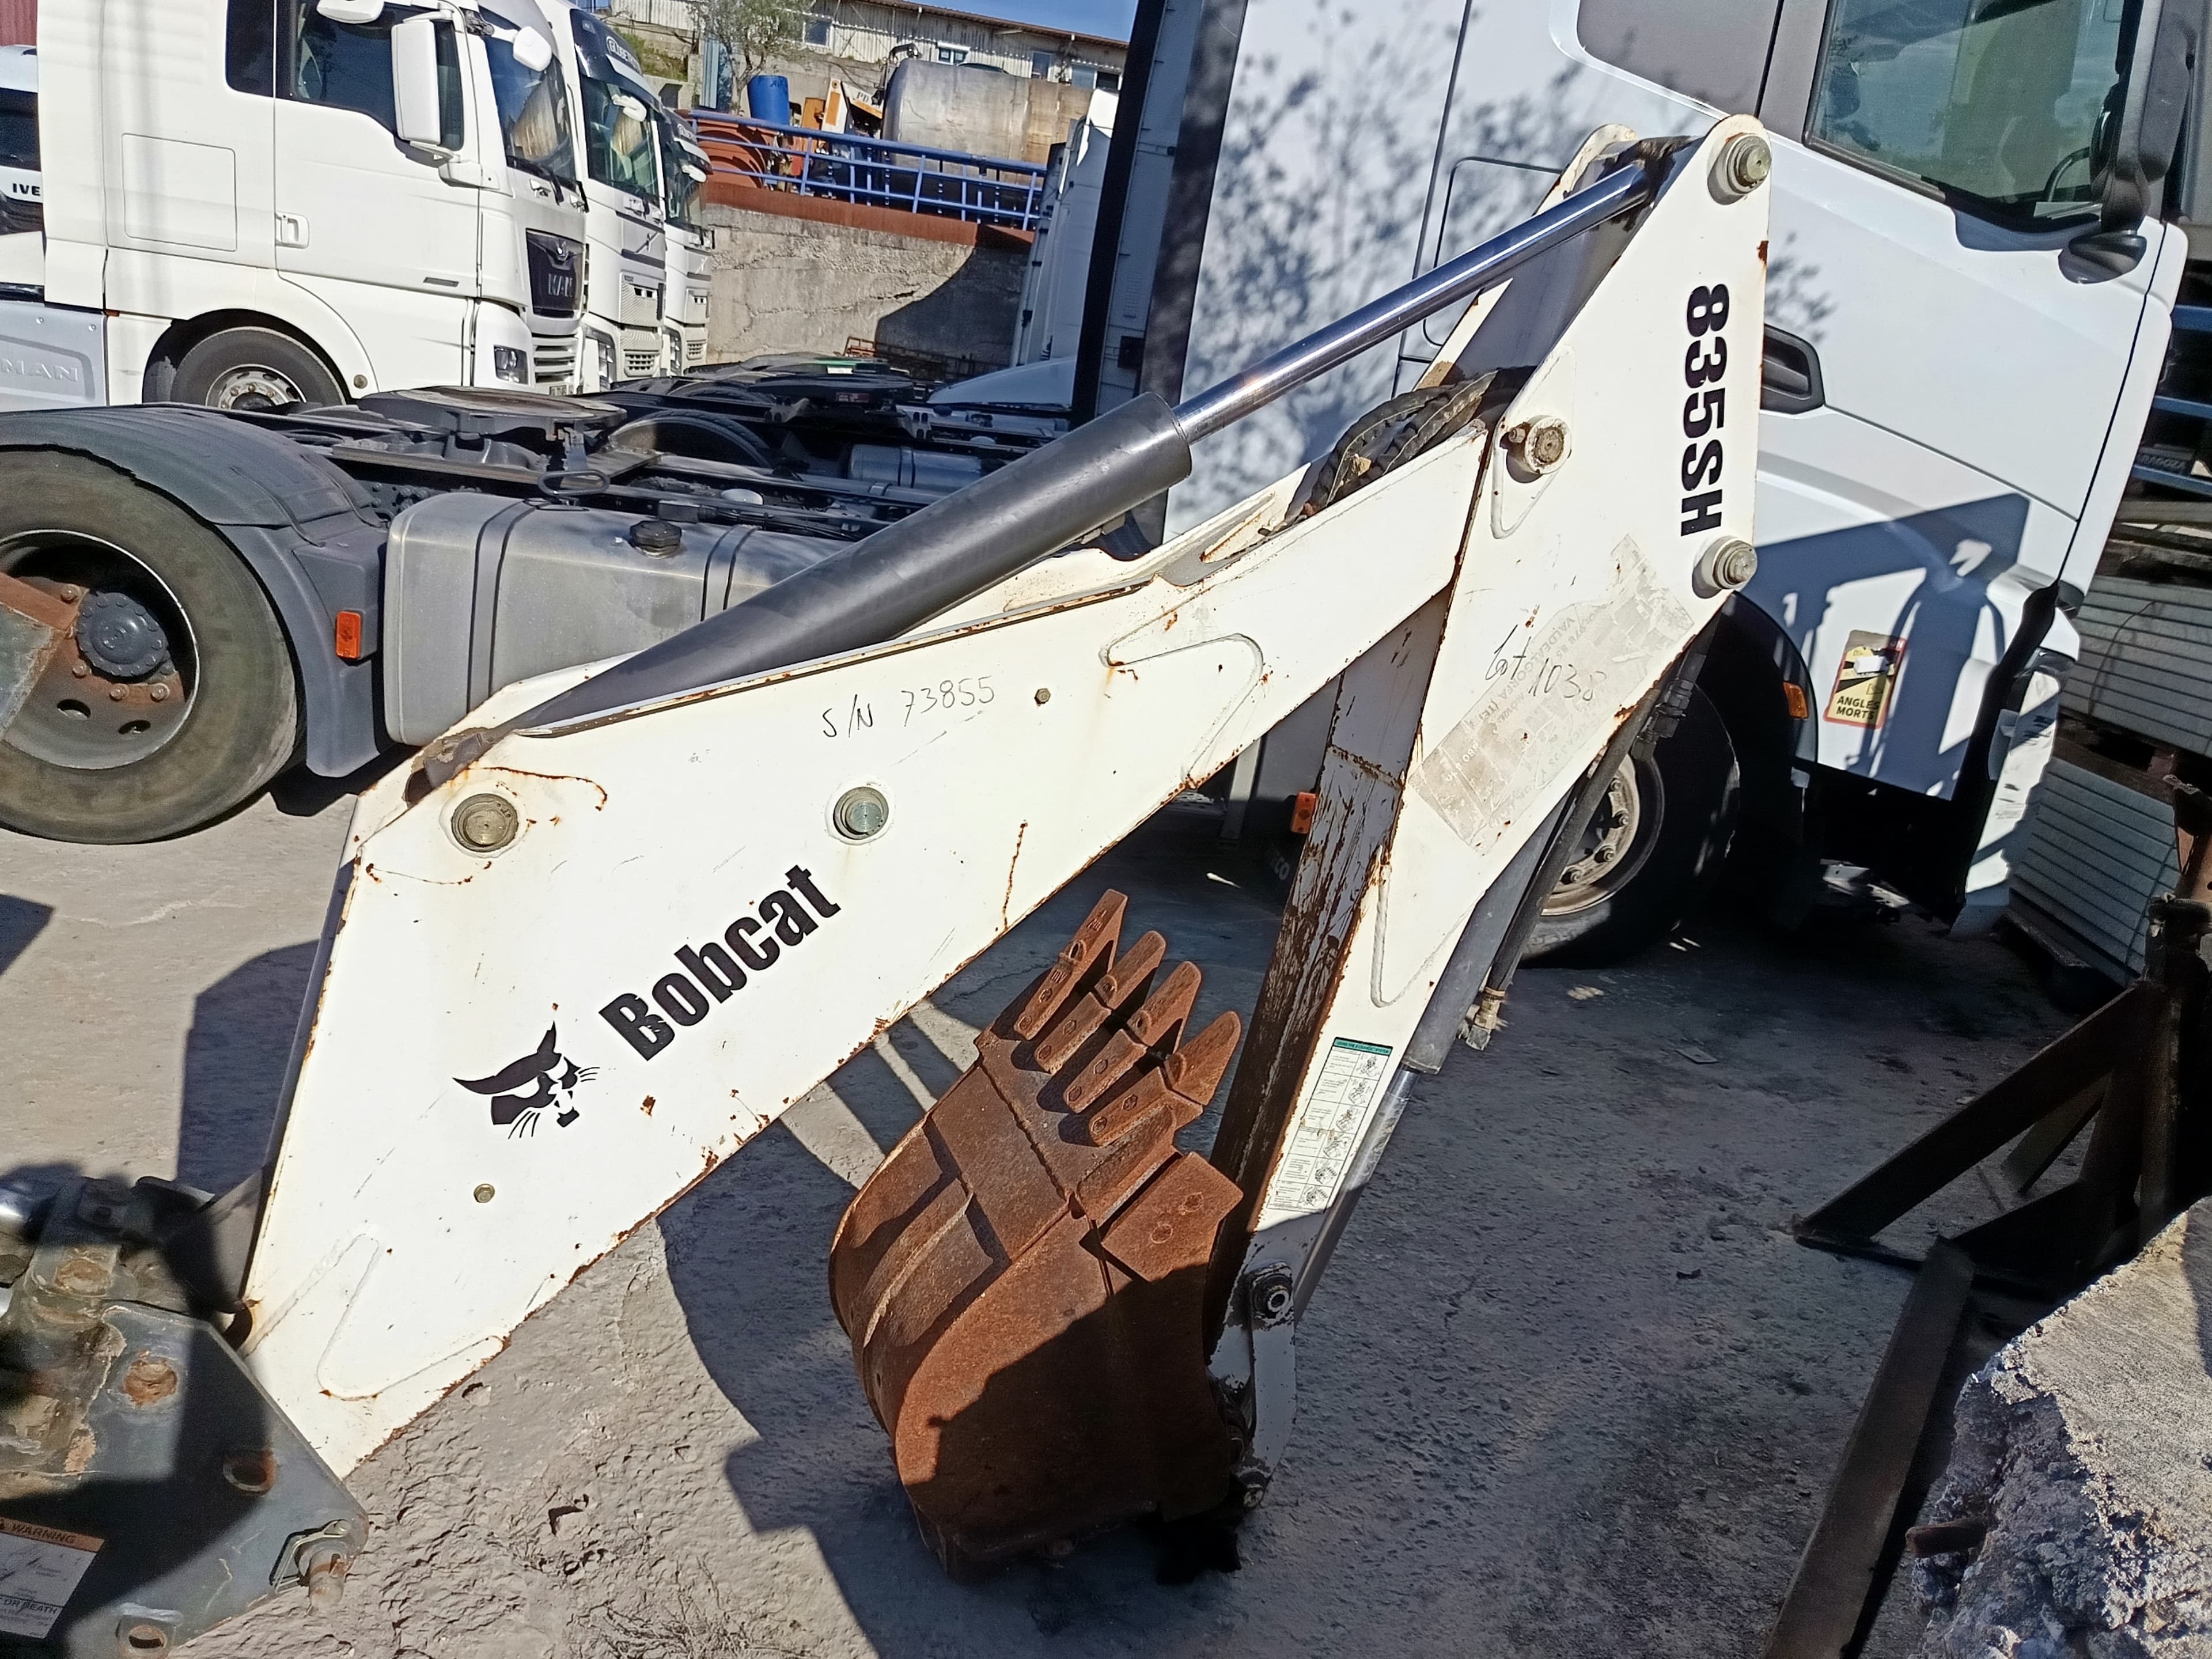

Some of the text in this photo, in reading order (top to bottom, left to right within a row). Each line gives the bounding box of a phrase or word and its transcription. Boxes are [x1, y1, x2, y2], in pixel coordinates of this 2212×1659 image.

[12, 183, 41, 196] IVE
[0, 359, 78, 382] MAN
[1680, 283, 1729, 537] 835SH
[823, 675, 994, 737] S/N 73855
[1836, 706, 1875, 719] MORTS
[1837, 696, 1880, 710] ANGLES
[599, 865, 842, 1061] Bobcat
[12, 1524, 75, 1544] WARNING
[4, 1599, 21, 1607] OR
